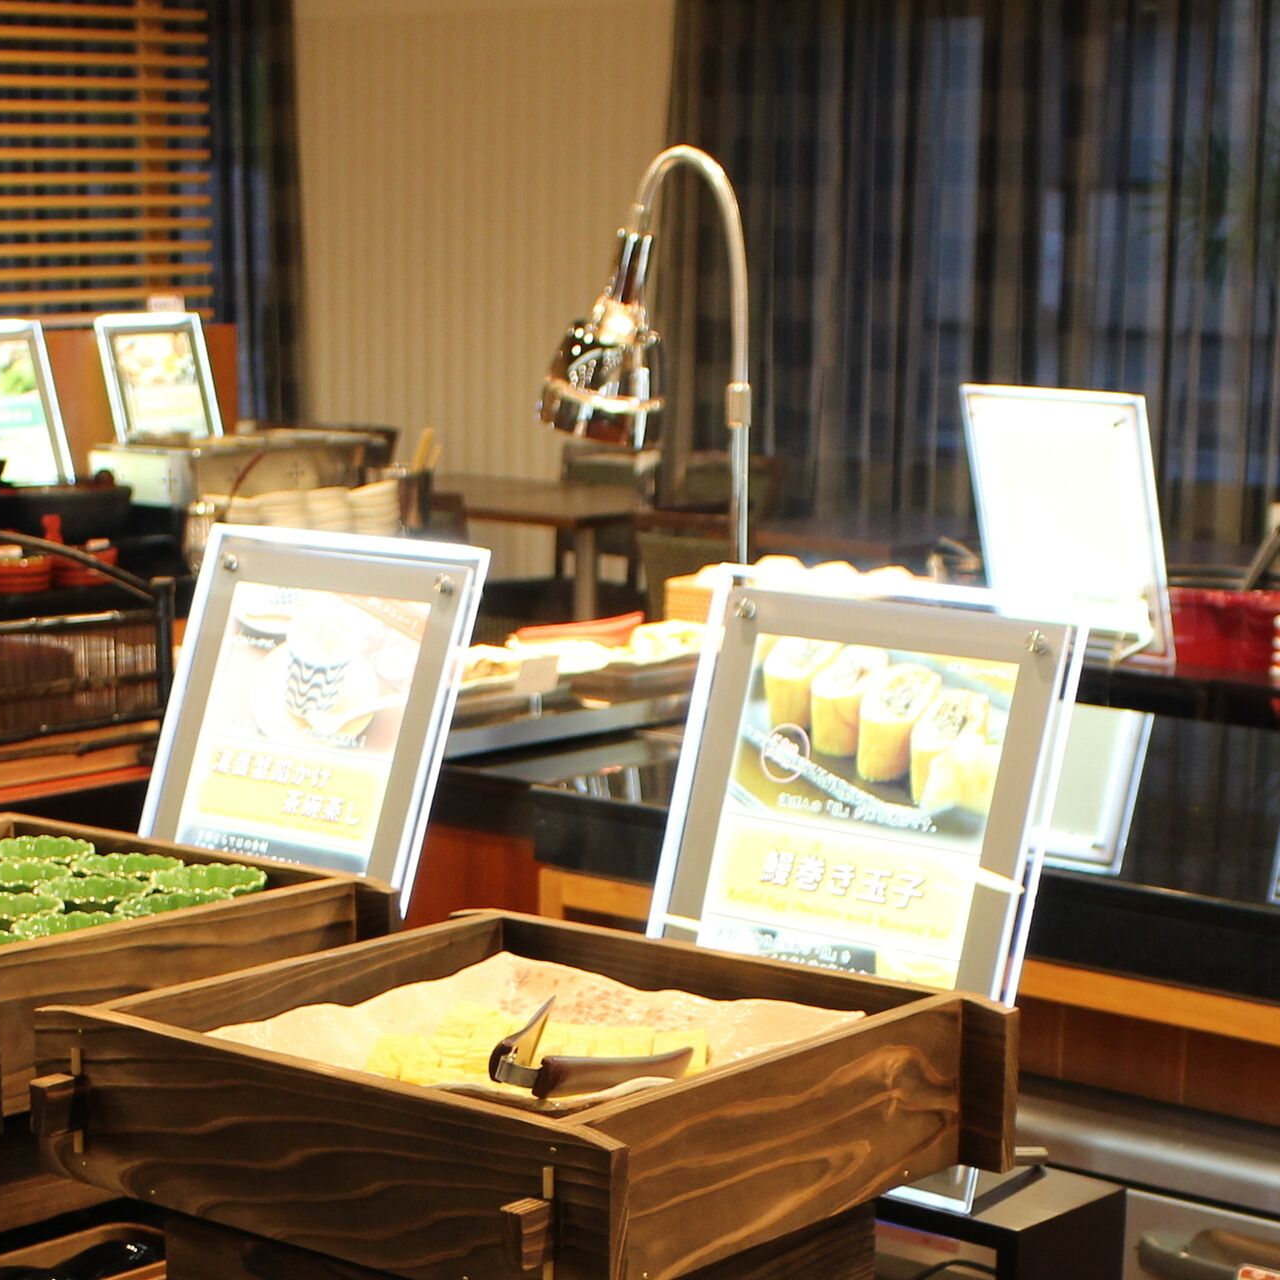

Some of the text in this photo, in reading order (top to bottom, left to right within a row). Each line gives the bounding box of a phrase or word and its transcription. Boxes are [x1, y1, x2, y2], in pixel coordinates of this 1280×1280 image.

[760, 849, 925, 909] 鰻巻き玉子
